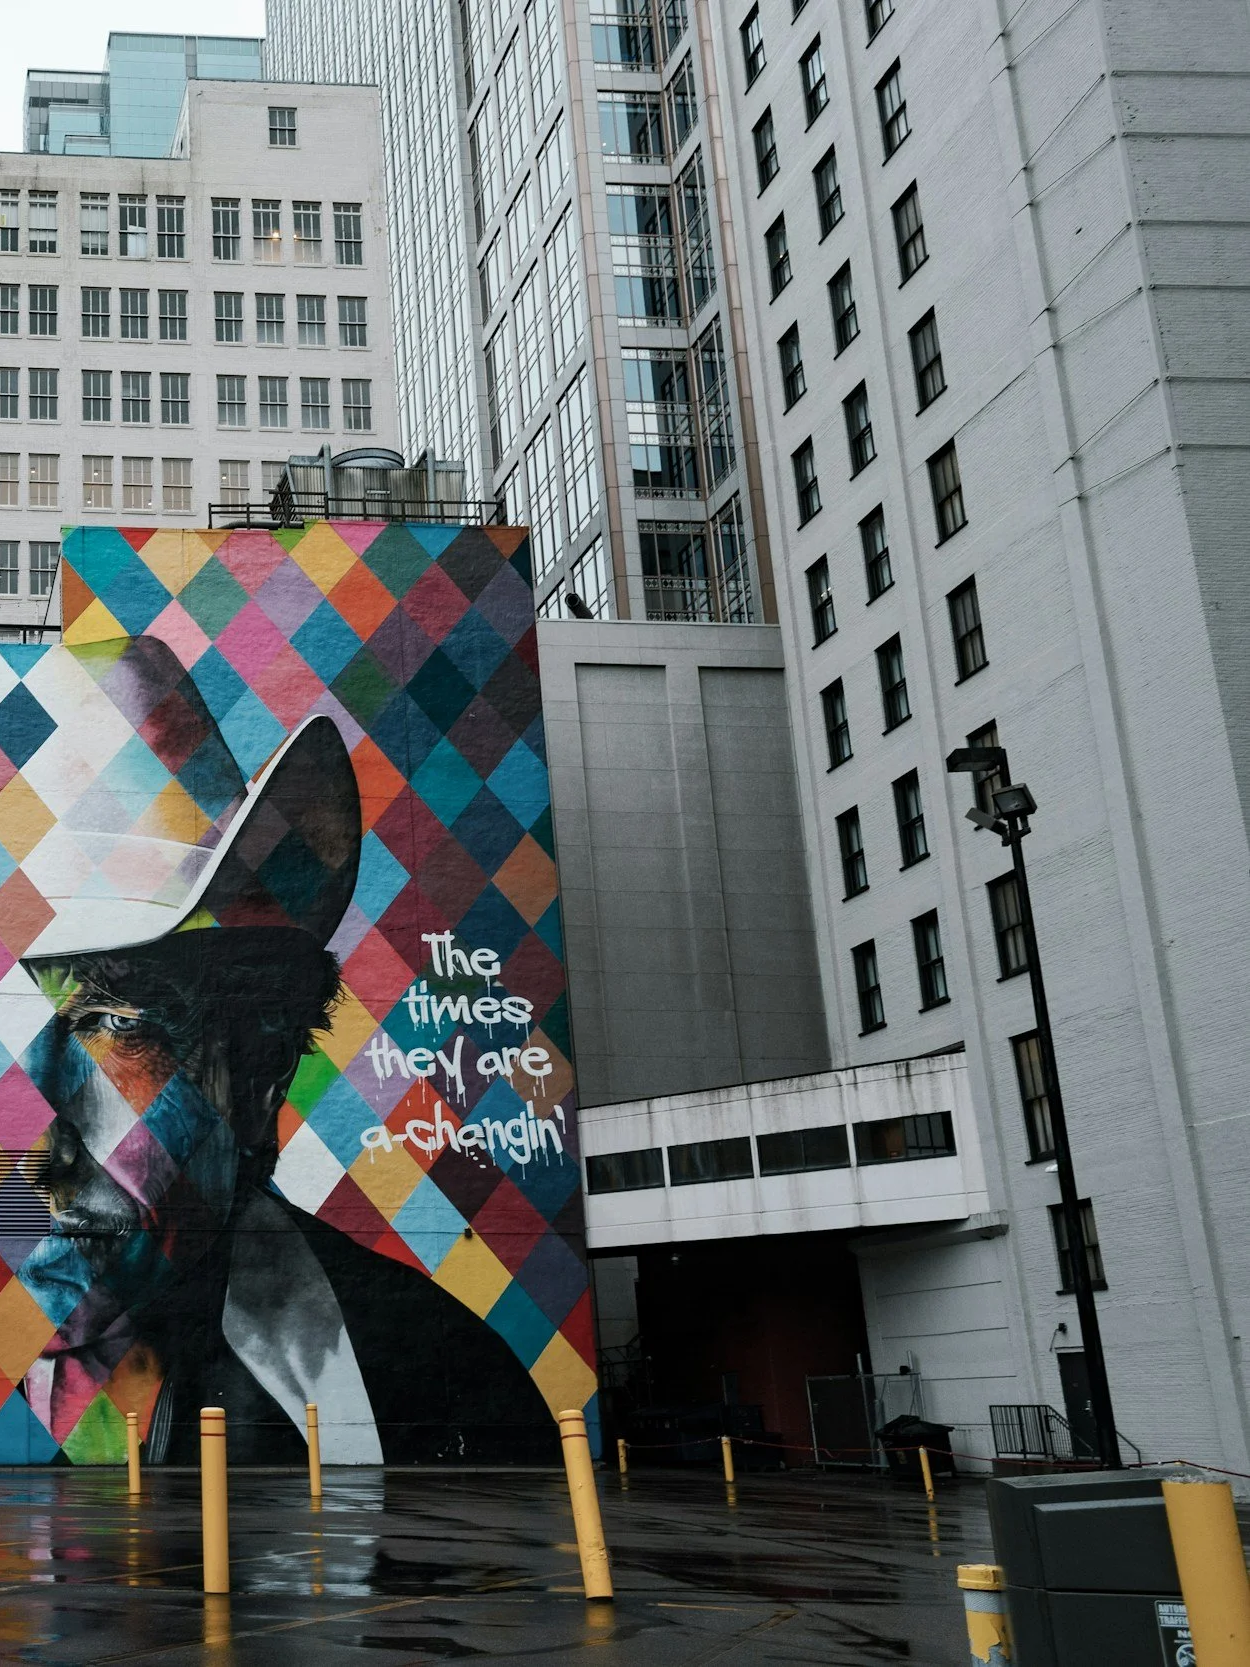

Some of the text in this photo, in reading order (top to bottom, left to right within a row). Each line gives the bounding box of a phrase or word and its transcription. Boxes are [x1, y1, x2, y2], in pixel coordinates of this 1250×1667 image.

[421, 930, 501, 979] The
[401, 980, 534, 1026] times
[364, 1033, 553, 1096] they are
[360, 1100, 566, 1166] a-changin'
[1158, 1604, 1188, 1613] AUTOM
